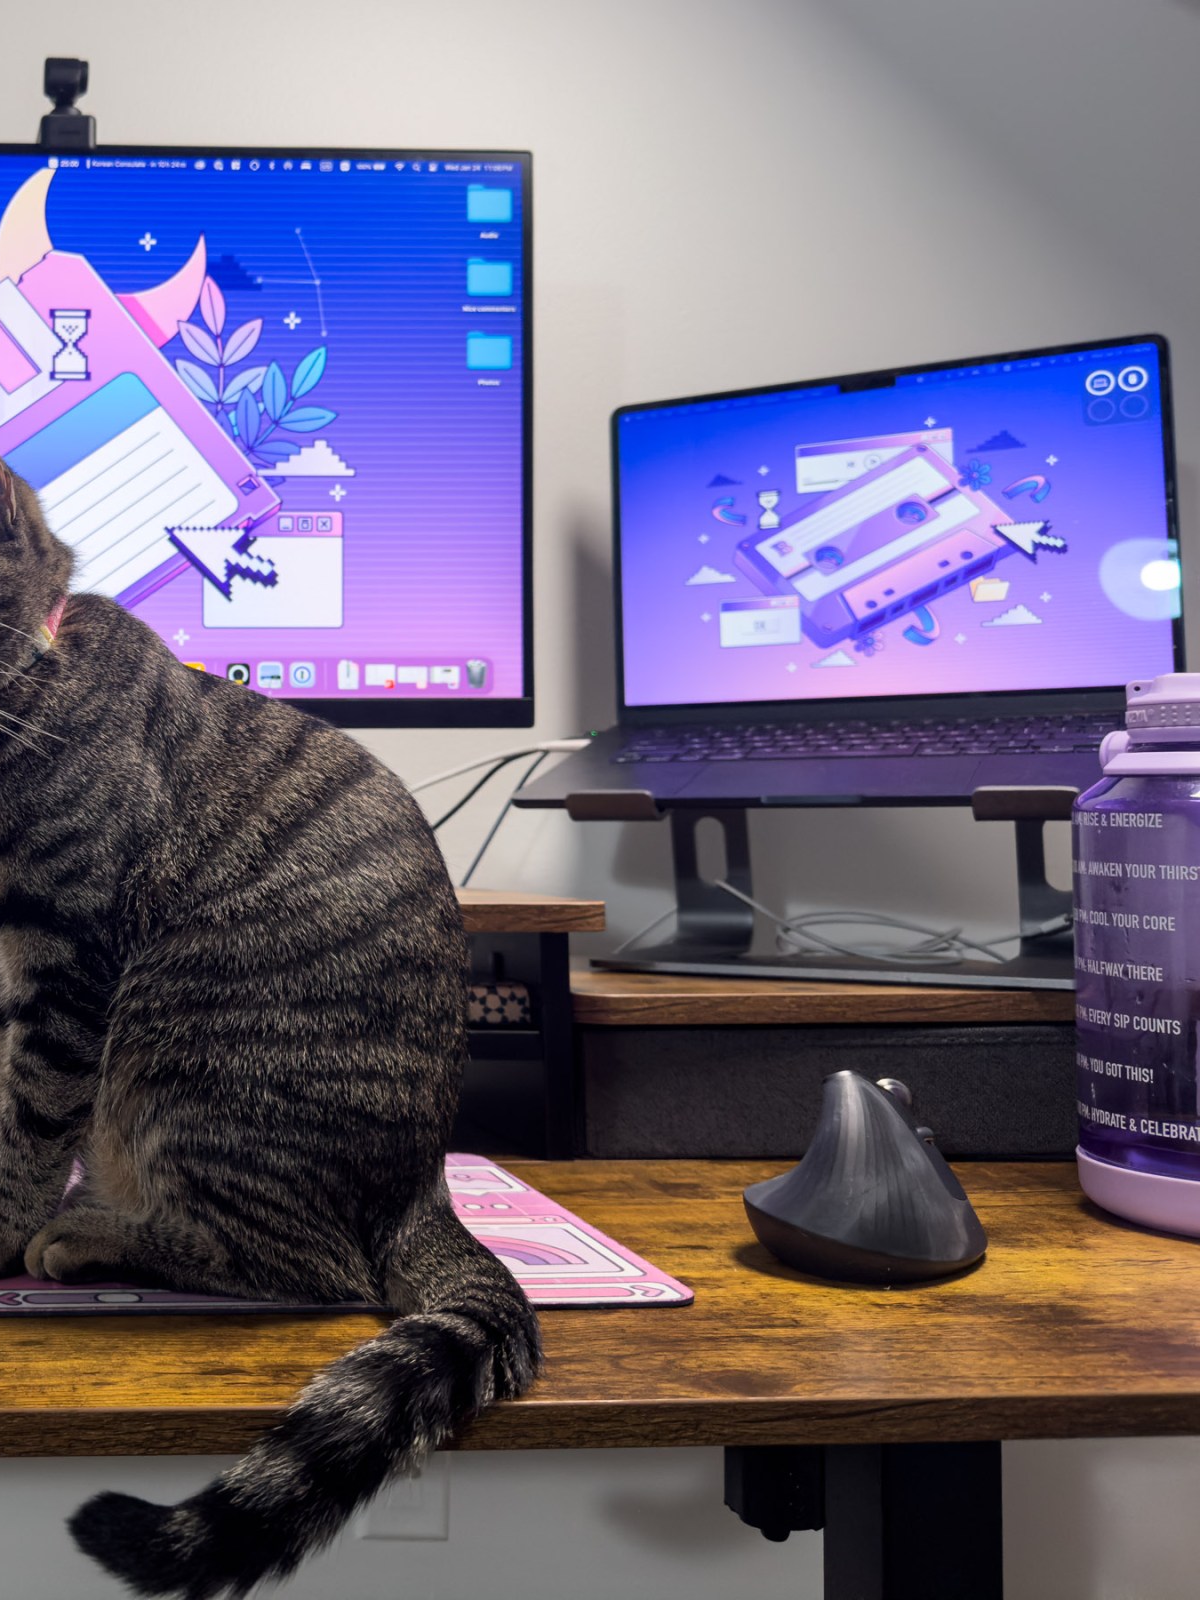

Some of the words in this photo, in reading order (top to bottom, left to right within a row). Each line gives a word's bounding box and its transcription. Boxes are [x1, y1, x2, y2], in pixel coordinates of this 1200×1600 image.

[1083, 811, 1099, 826] RISE
[1101, 813, 1108, 827] &
[1110, 812, 1163, 828] ENERGIZE
[1088, 861, 1122, 877] AWAKEN
[1124, 863, 1156, 879] YOUR
[1090, 910, 1109, 926] COOL
[1112, 912, 1140, 929] YOUR
[1143, 915, 1176, 931] CORE
[1088, 959, 1124, 978] HALFWAY
[1126, 964, 1163, 982] THERE
[1089, 1008, 1112, 1026] EVERY
[1114, 1012, 1130, 1029] SIP
[1133, 1015, 1181, 1035] COUNTS
[1090, 1057, 1103, 1074] YOU
[1105, 1061, 1123, 1079] GOT
[1124, 1065, 1154, 1084] THIS!
[1091, 1107, 1127, 1130] HYDRATE
[1129, 1118, 1137, 1132] &
